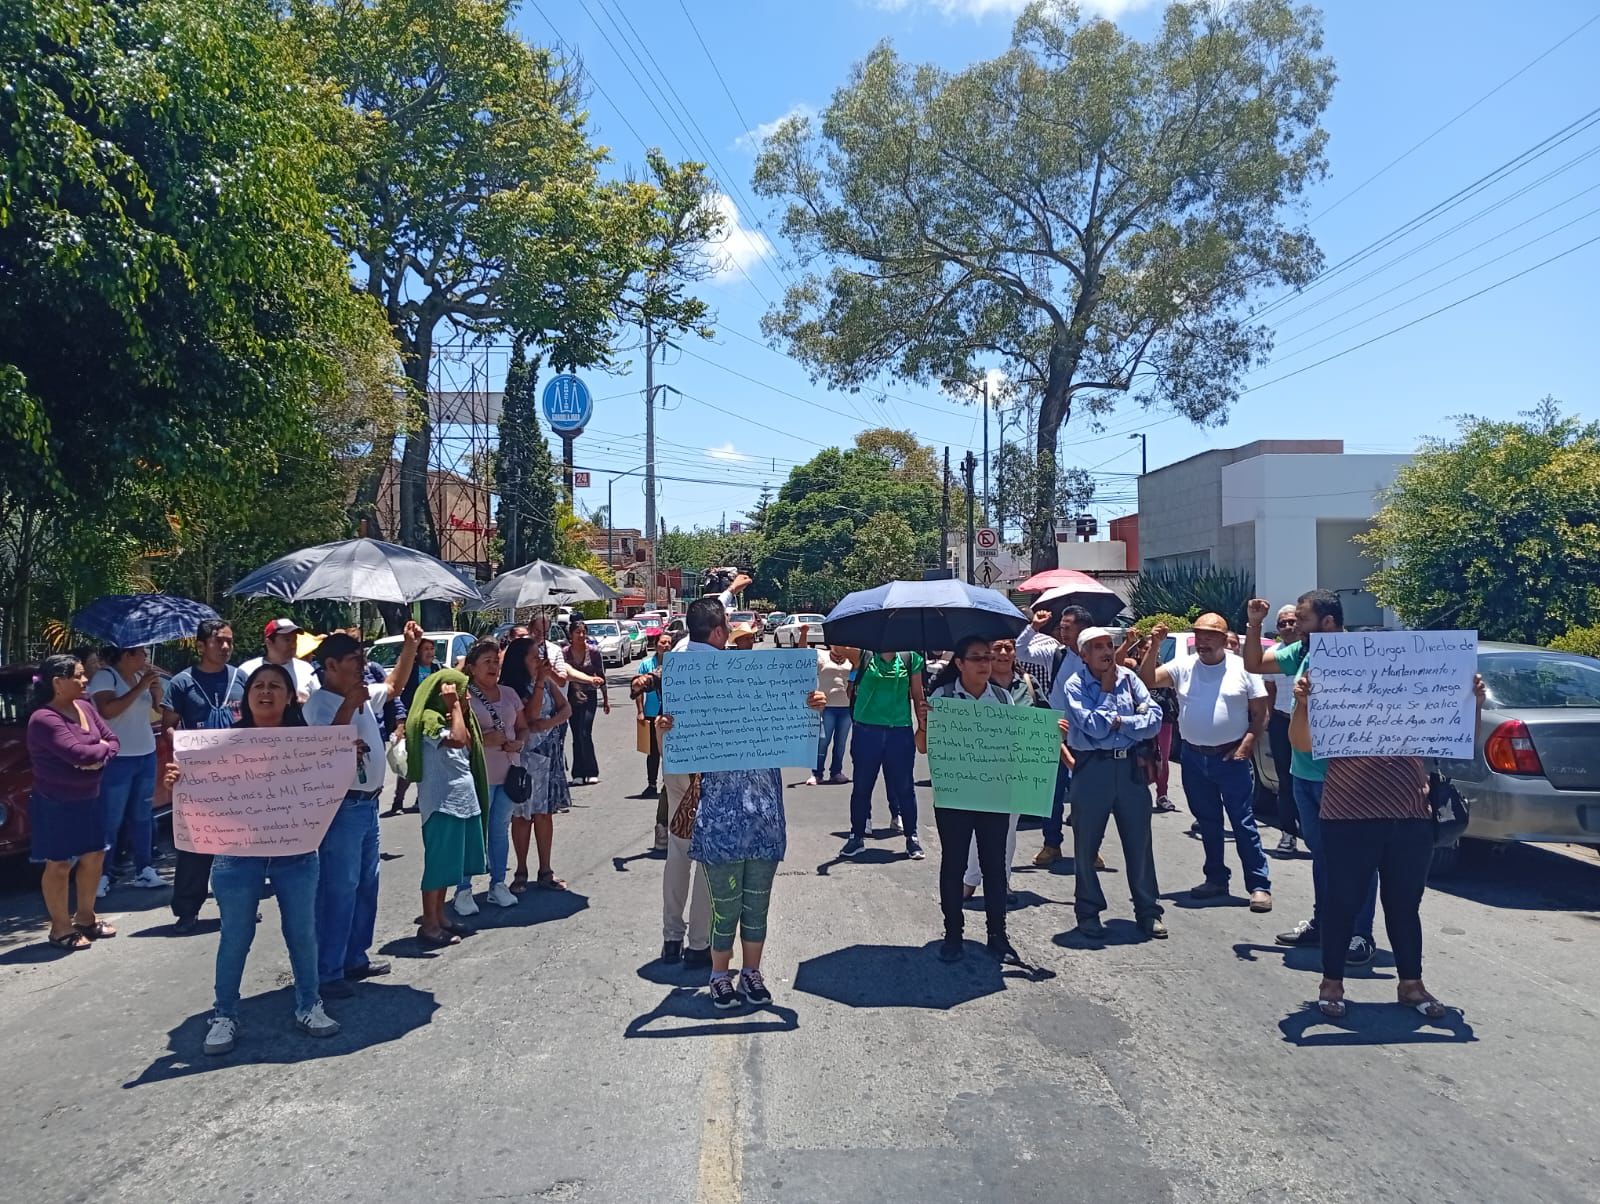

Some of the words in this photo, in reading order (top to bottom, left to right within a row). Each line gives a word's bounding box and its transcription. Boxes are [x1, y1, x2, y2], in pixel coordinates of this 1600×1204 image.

[576, 474, 587, 483] 24
[1460, 638, 1474, 650] de
[706, 656, 718, 671] de
[766, 657, 778, 670] de
[779, 664, 792, 676] que
[1371, 669, 1378, 682] y
[1431, 684, 1462, 696] niega
[1386, 703, 1402, 716] que
[1348, 714, 1362, 727] de
